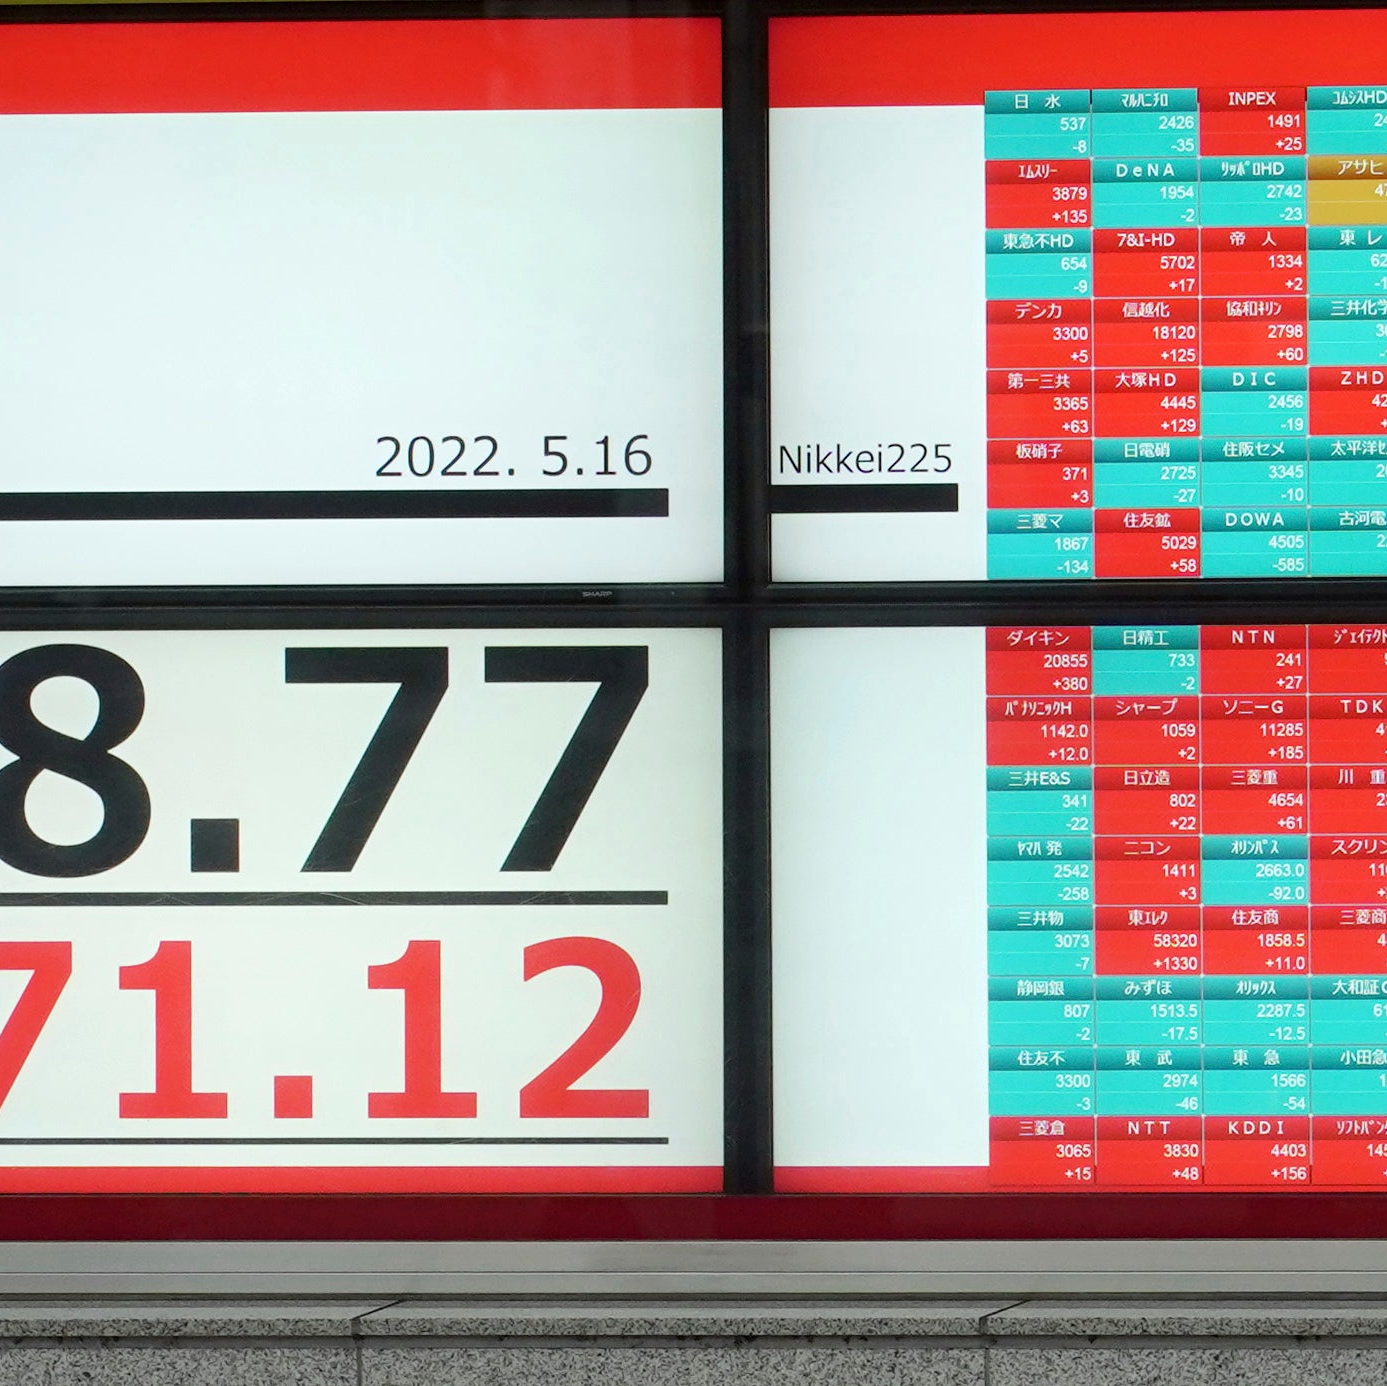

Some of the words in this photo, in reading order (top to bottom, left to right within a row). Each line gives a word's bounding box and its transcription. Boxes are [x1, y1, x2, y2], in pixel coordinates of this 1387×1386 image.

[1229, 92, 1275, 105] INPEX
[1268, 114, 1299, 127] 1491
[1276, 137, 1302, 150] +25
[1003, 233, 1073, 249] 東急不HD
[1117, 233, 1175, 246] 7&I-HD
[1061, 257, 1087, 270] 654
[1161, 256, 1195, 269] 5702
[1074, 280, 1087, 293] -9
[1169, 278, 1195, 291] +17
[1016, 303, 1061, 318] デンカ
[1054, 327, 1088, 340] 3300
[1071, 350, 1088, 363] +5
[1008, 373, 1070, 388] 第一三共
[1054, 397, 1088, 410] 3365
[1062, 420, 1088, 433] +63
[779, 444, 952, 473] Nikkei225
[1124, 512, 1171, 527] 住友鉱
[1162, 536, 1196, 549] 5029
[1171, 559, 1197, 572] +58
[1007, 630, 1069, 645] ダイキン
[1044, 654, 1087, 667] 20855
[1053, 677, 1087, 690] +380
[1116, 699, 1178, 715] シャープ
[1162, 724, 1195, 737] 1059
[1179, 747, 1195, 760] +2
[1125, 841, 1170, 855] ニコン
[1163, 864, 1194, 877] 1411
[1179, 887, 1196, 900] +3
[1018, 910, 1063, 925] 三井物
[1232, 909, 1278, 925] 住友商
[1055, 934, 1090, 948] 3073
[1258, 934, 1305, 947] 1858.5
[1076, 957, 1090, 970] -7
[1266, 957, 1305, 969] +11.0
[1125, 979, 1171, 995] みずほ
[1151, 1004, 1197, 1017] 1513.5
[1162, 1027, 1198, 1040] -17.5
